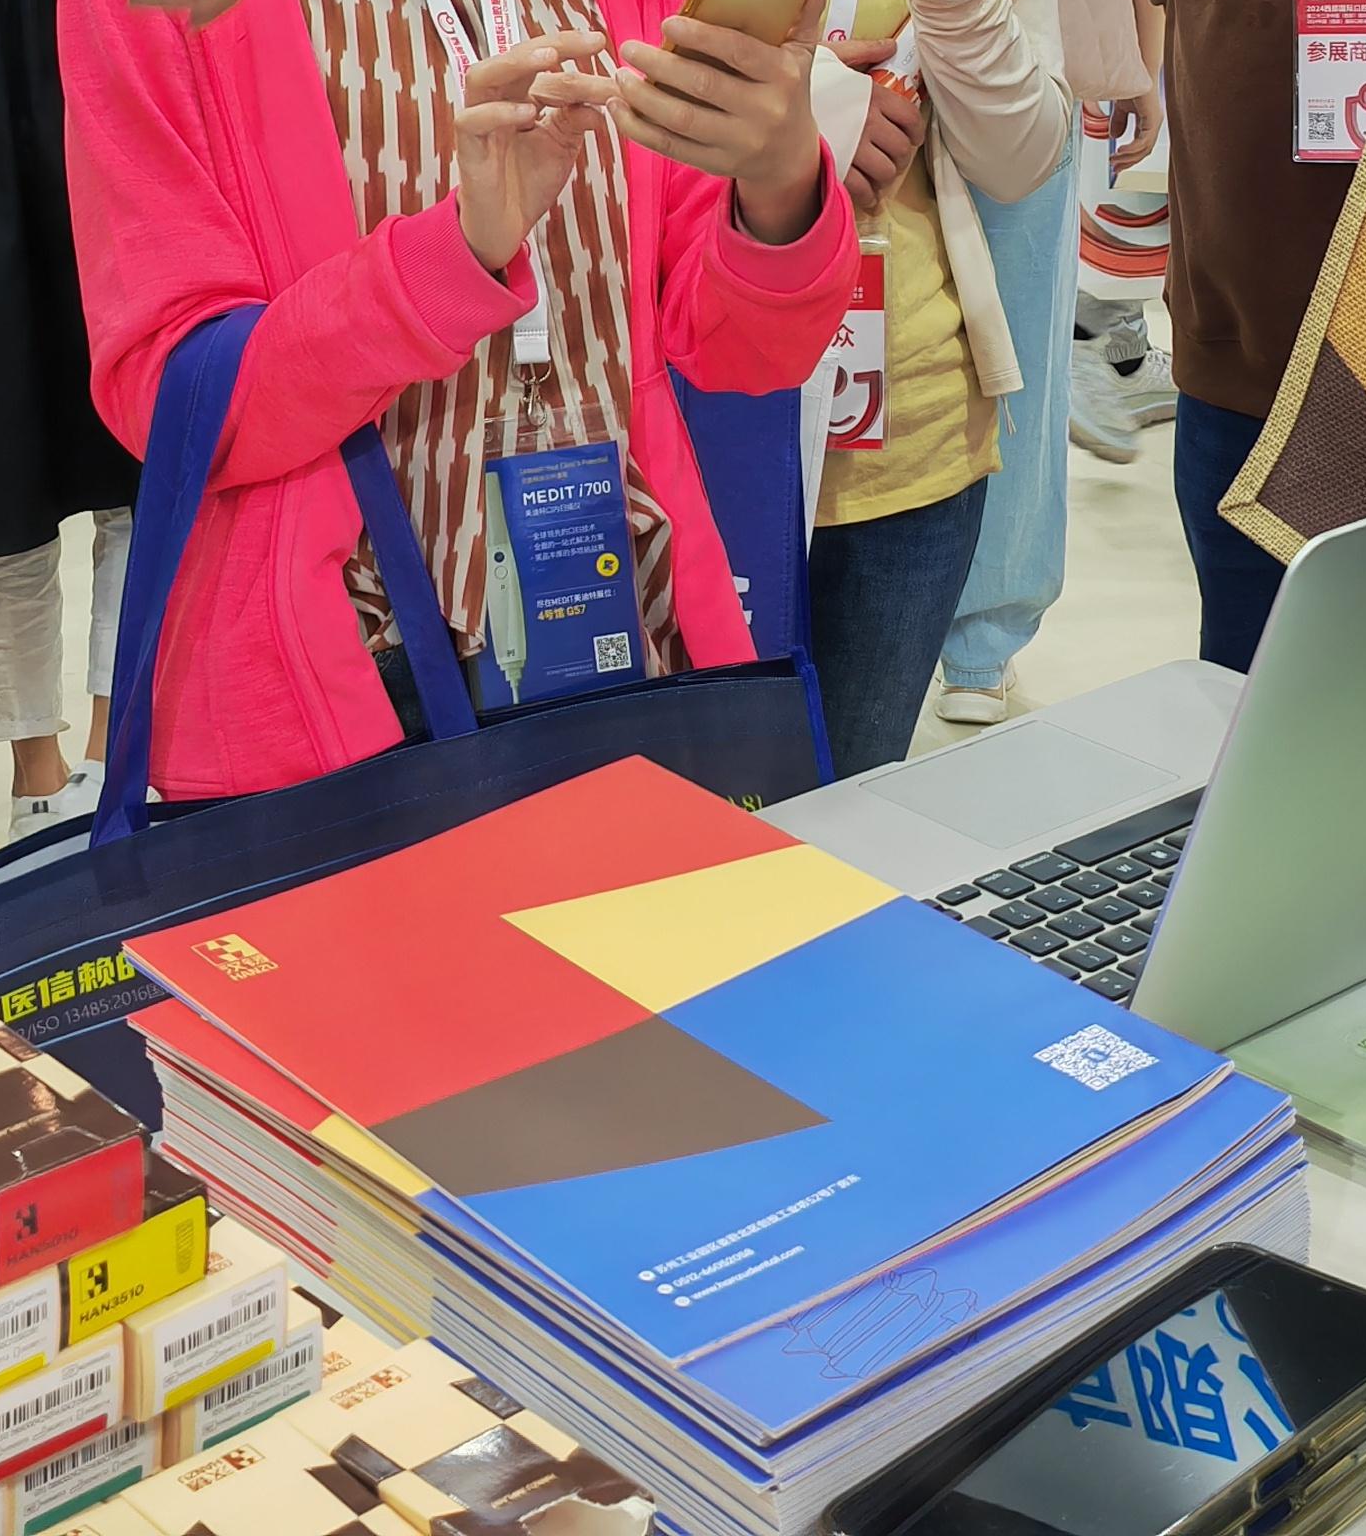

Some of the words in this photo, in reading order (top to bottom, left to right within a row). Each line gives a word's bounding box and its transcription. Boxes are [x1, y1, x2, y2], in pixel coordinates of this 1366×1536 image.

[522, 485, 576, 507] MEDIT
[578, 479, 612, 499] i700
[79, 1282, 145, 1325] HAN3510
